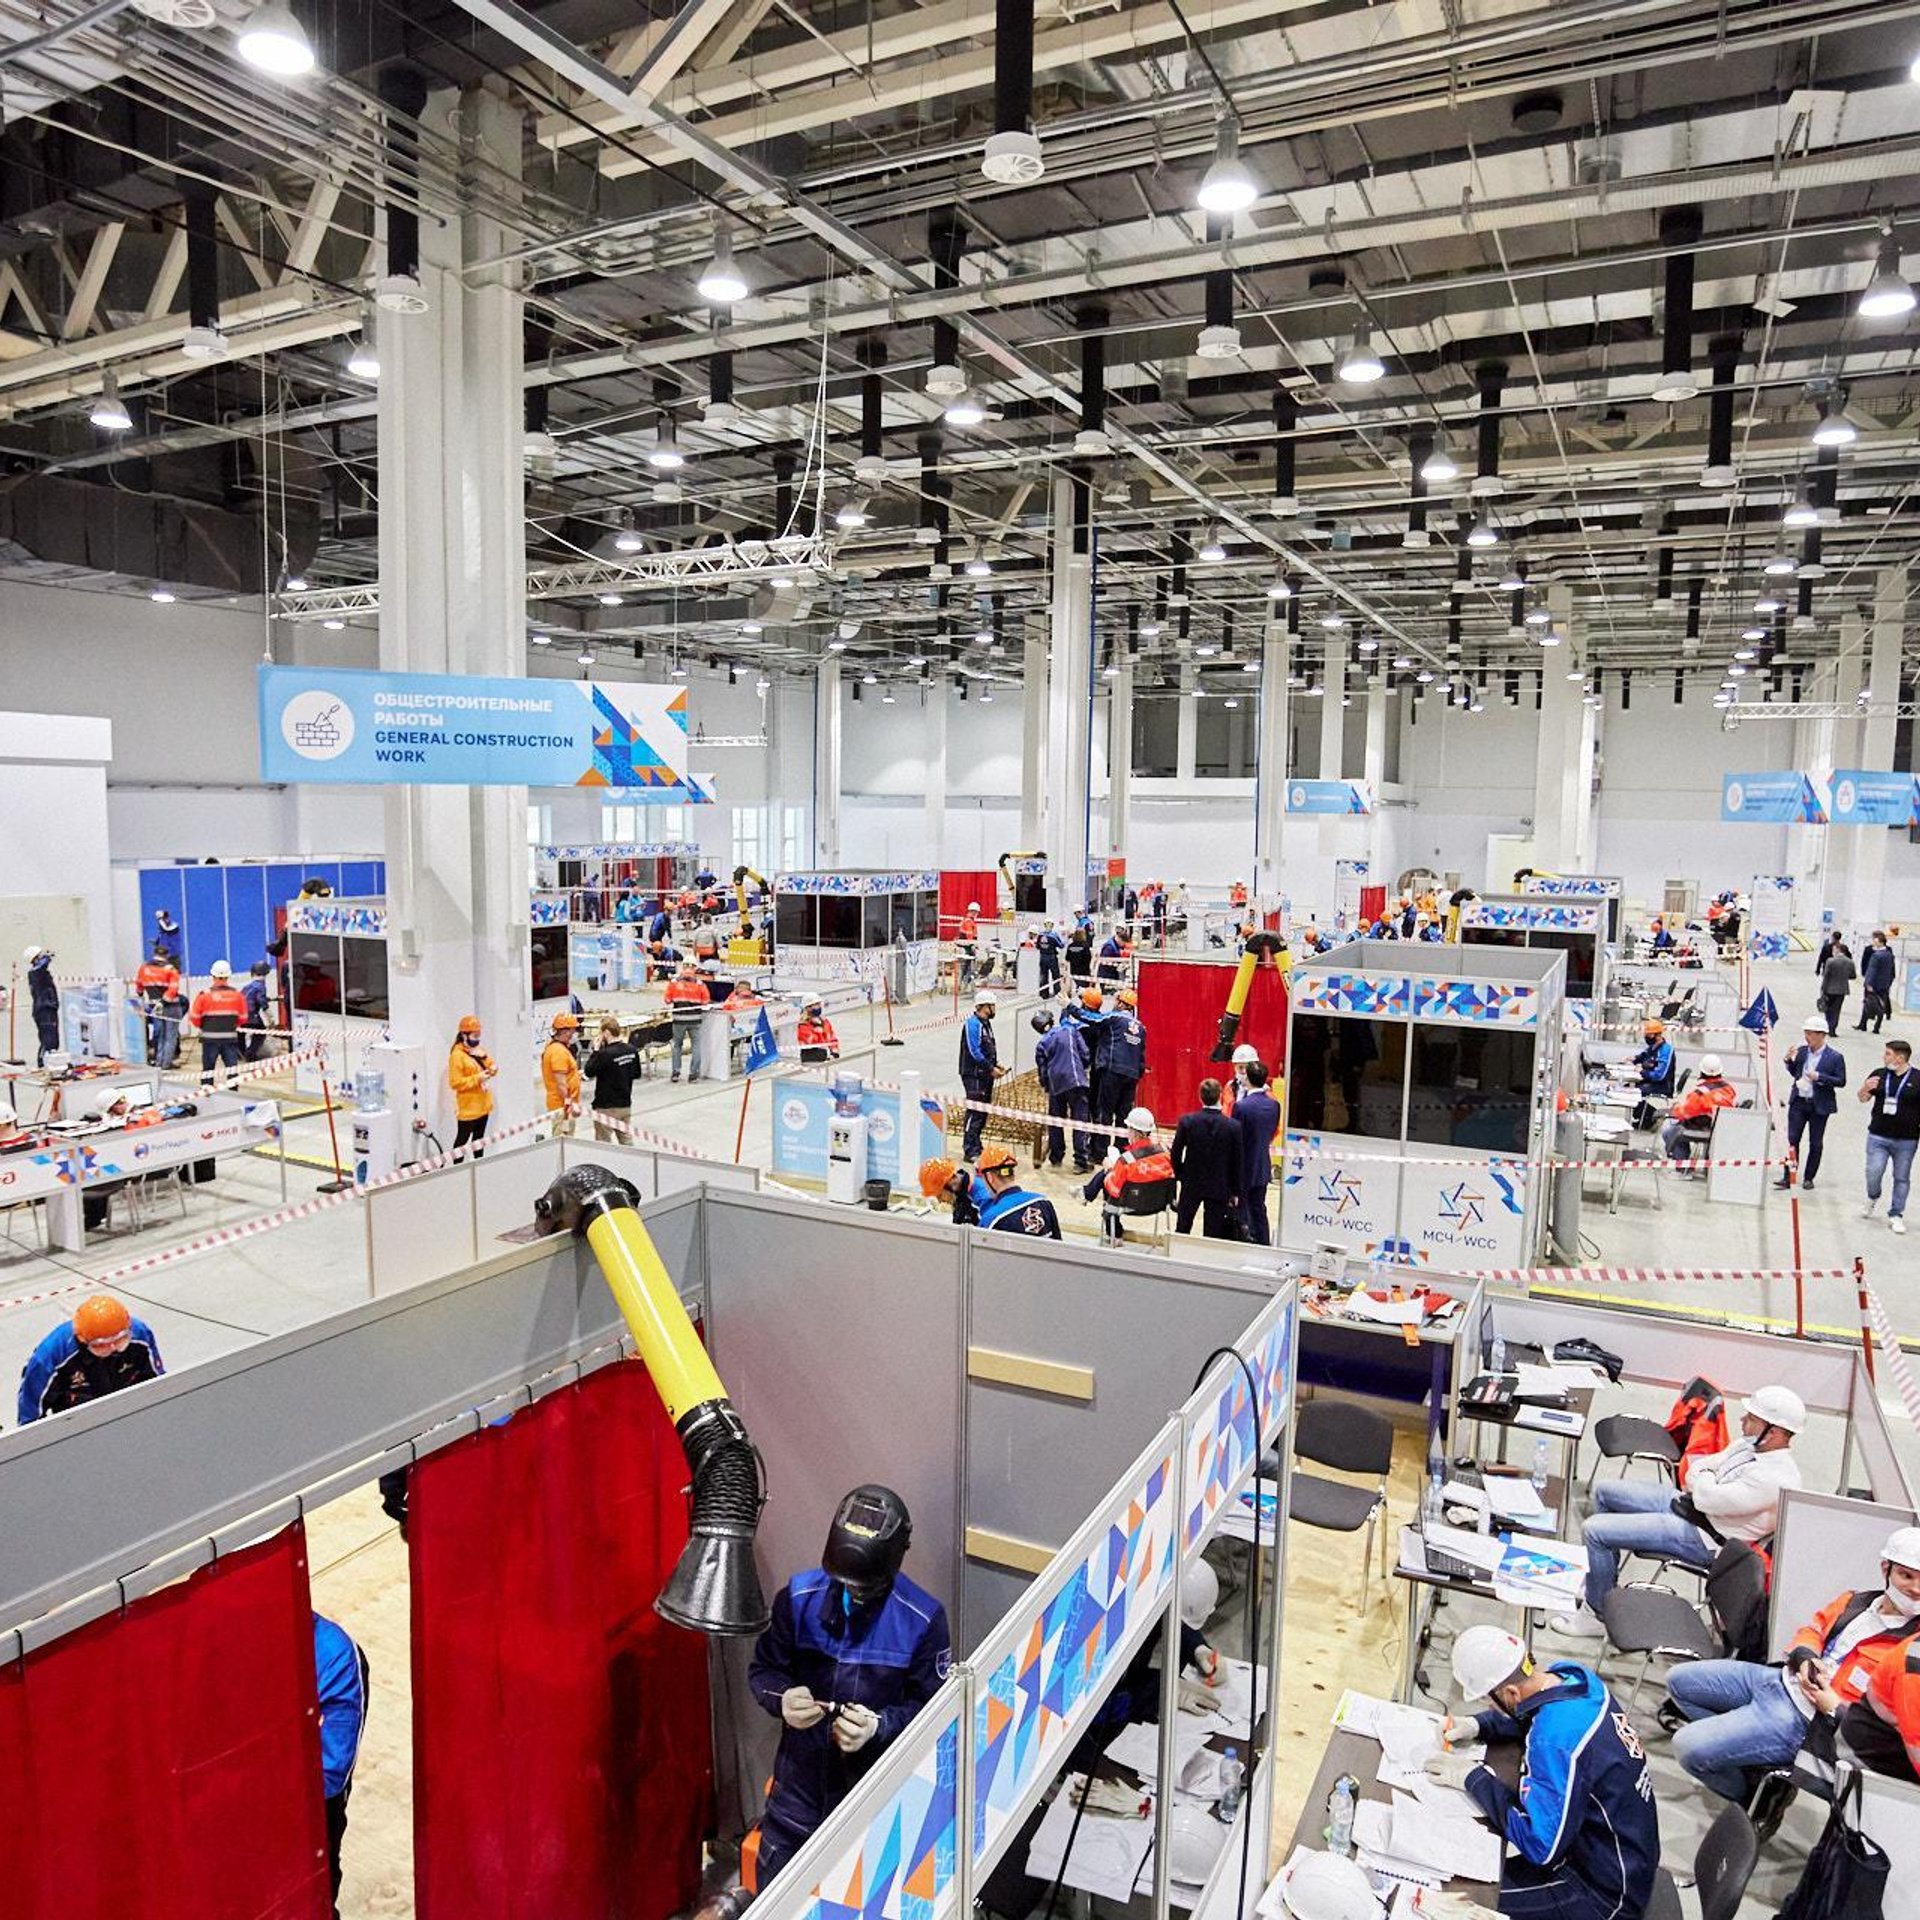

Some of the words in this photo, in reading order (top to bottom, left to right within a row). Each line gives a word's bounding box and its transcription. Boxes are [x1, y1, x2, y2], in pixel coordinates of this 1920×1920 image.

[374, 692, 553, 713] ОБЩЕСТРОИТЕЛЬНЫЕ
[374, 711, 444, 726] РАБОТЫ
[375, 731, 450, 745] GENERAL
[454, 733, 574, 748] CONSTRUCTION
[376, 749, 426, 763] WORK
